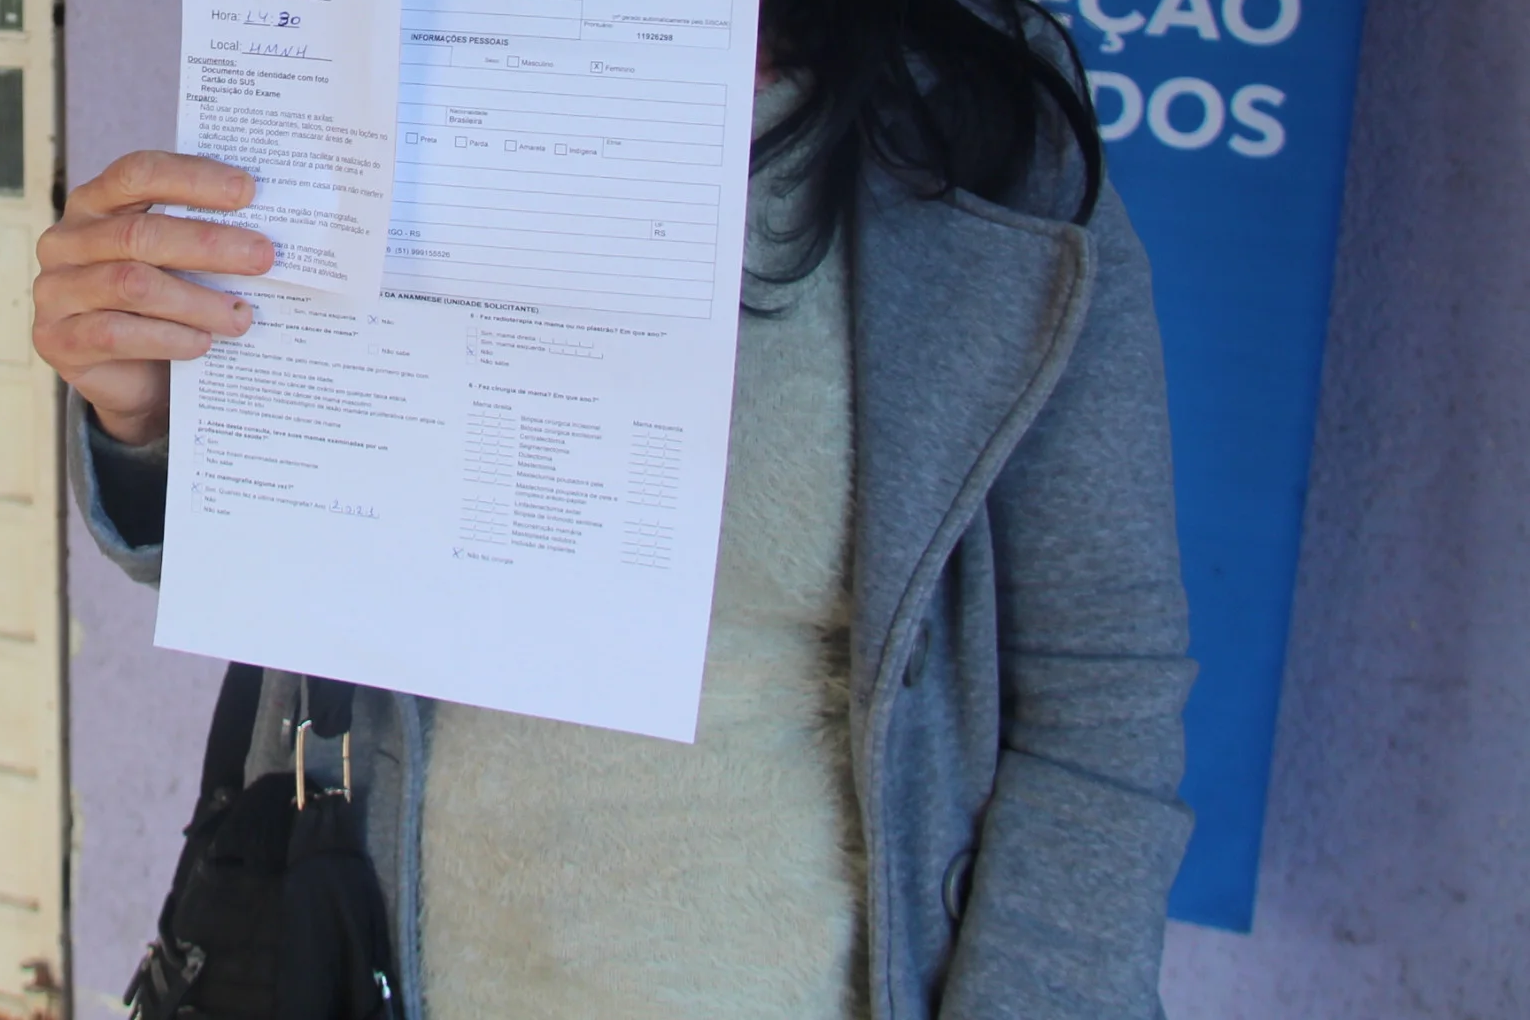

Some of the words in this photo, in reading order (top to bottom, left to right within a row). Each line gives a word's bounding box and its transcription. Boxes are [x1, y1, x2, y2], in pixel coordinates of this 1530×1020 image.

[212, 10, 241, 21] Hora:
[211, 39, 242, 51] Local:
[411, 34, 467, 44] INFORMAÇÕES
[469, 37, 509, 46] PESSOAIS
[187, 55, 237, 66] Documentos:
[521, 60, 554, 68] Masculino
[201, 66, 244, 76] Documento
[246, 69, 256, 77] de
[257, 70, 296, 81] identidade
[314, 75, 329, 84] foto
[201, 75, 226, 84] Cartão
[227, 77, 237, 85] do
[239, 78, 256, 86] SUS
[201, 84, 242, 96] Requisição
[243, 88, 254, 96] do
[255, 89, 281, 98] Exame
[186, 93, 218, 103] Preparo:
[200, 103, 215, 112] Não
[233, 107, 264, 116] produtos
[1085, 69, 1286, 158] DOS
[200, 113, 217, 121] Evite
[239, 116, 249, 124] de
[449, 116, 483, 125] Brasileira
[199, 122, 210, 130] dia
[211, 123, 221, 131] do
[249, 128, 264, 136] pois
[265, 129, 290, 138] podem
[198, 132, 239, 143] calcificação
[420, 135, 437, 143] Preta
[469, 139, 488, 148] Parda
[198, 141, 211, 149] Use
[213, 144, 237, 153] roupas
[238, 145, 248, 153] de
[249, 146, 267, 155] duas
[268, 149, 290, 158] peças
[224, 153, 238, 162] pois
[258, 158, 291, 167] precisará
[277, 178, 298, 186] anéis
[276, 205, 287, 214] da
[288, 208, 312, 217] região
[268, 215, 288, 223] pode
[654, 229, 666, 237] RS
[275, 250, 285, 258] de
[286, 252, 296, 260] 15
[395, 247, 409, 255] (51)
[398, 293, 442, 303] ANAMNESE
[443, 297, 482, 308] (UNIDADE
[484, 302, 539, 315] SOLICITANTE)
